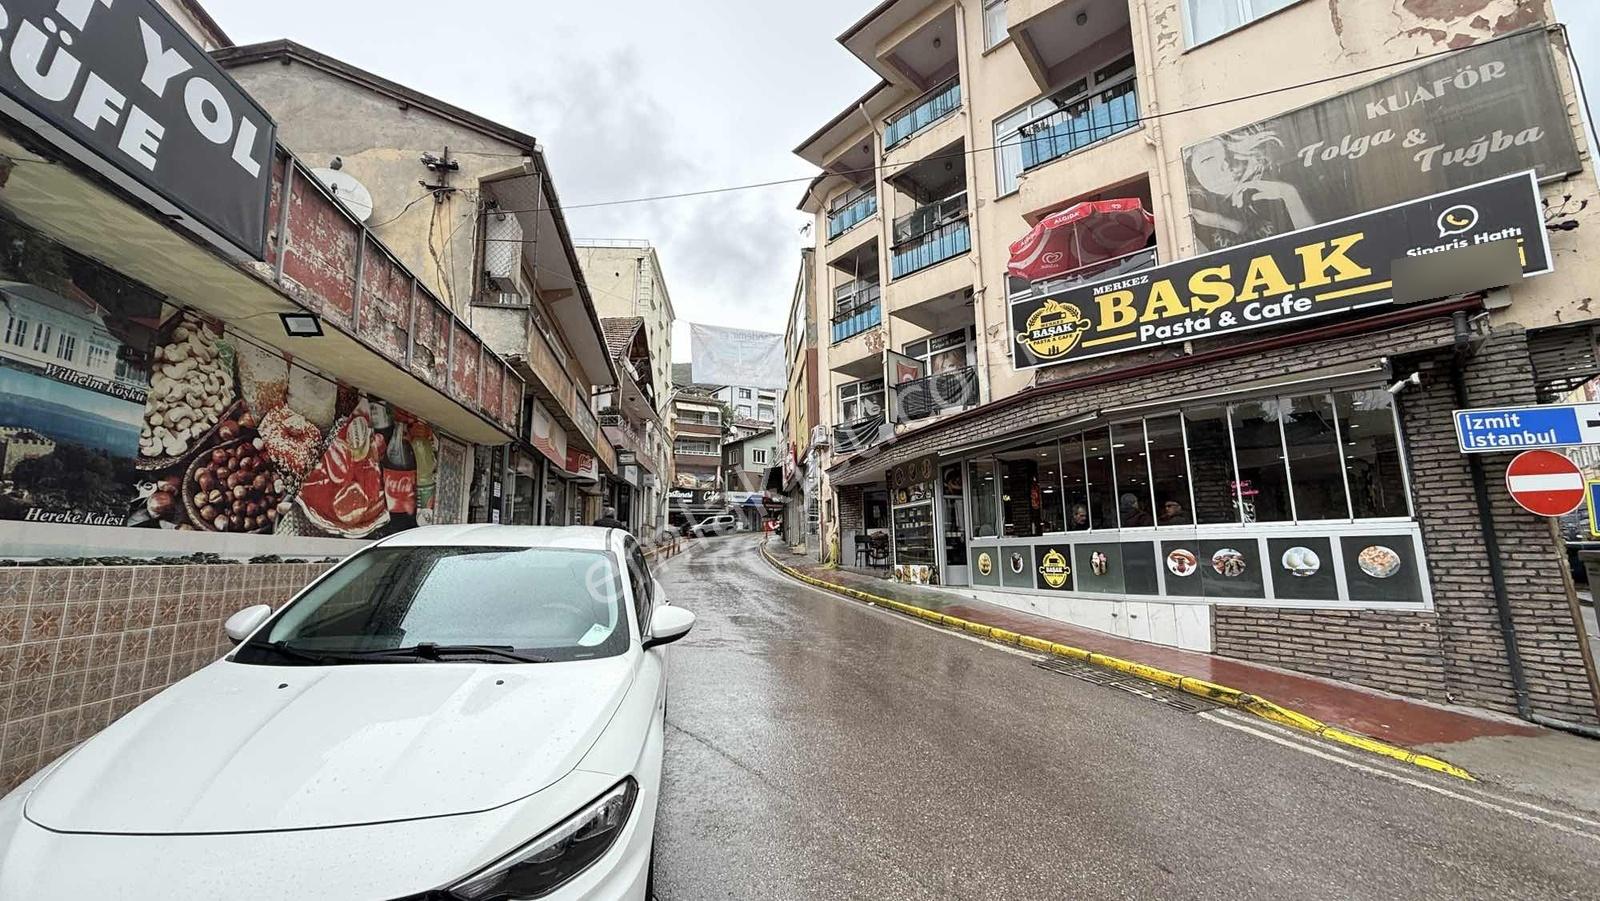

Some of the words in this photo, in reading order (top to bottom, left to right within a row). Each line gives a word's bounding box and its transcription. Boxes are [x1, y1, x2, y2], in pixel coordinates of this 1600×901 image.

[0, 3, 165, 171] ÜFE
[139, 16, 261, 179] YOL
[1366, 60, 1506, 119] KUAFÖR
[1298, 127, 1396, 167] Tolga
[1402, 127, 1428, 148] &
[1414, 126, 1544, 172] Tuğba
[1093, 274, 1149, 296] MERKEZ
[1095, 232, 1371, 332] BAŞAK
[1032, 323, 1074, 339] BAŞAK
[1140, 316, 1211, 342] Pasta
[1218, 311, 1238, 327] &
[1243, 293, 1312, 321] Cafe
[45, 363, 104, 390] Wilhelm
[106, 381, 146, 402] Köşkü
[25, 507, 81, 523] Hereke
[83, 511, 125, 526] Kalesi
